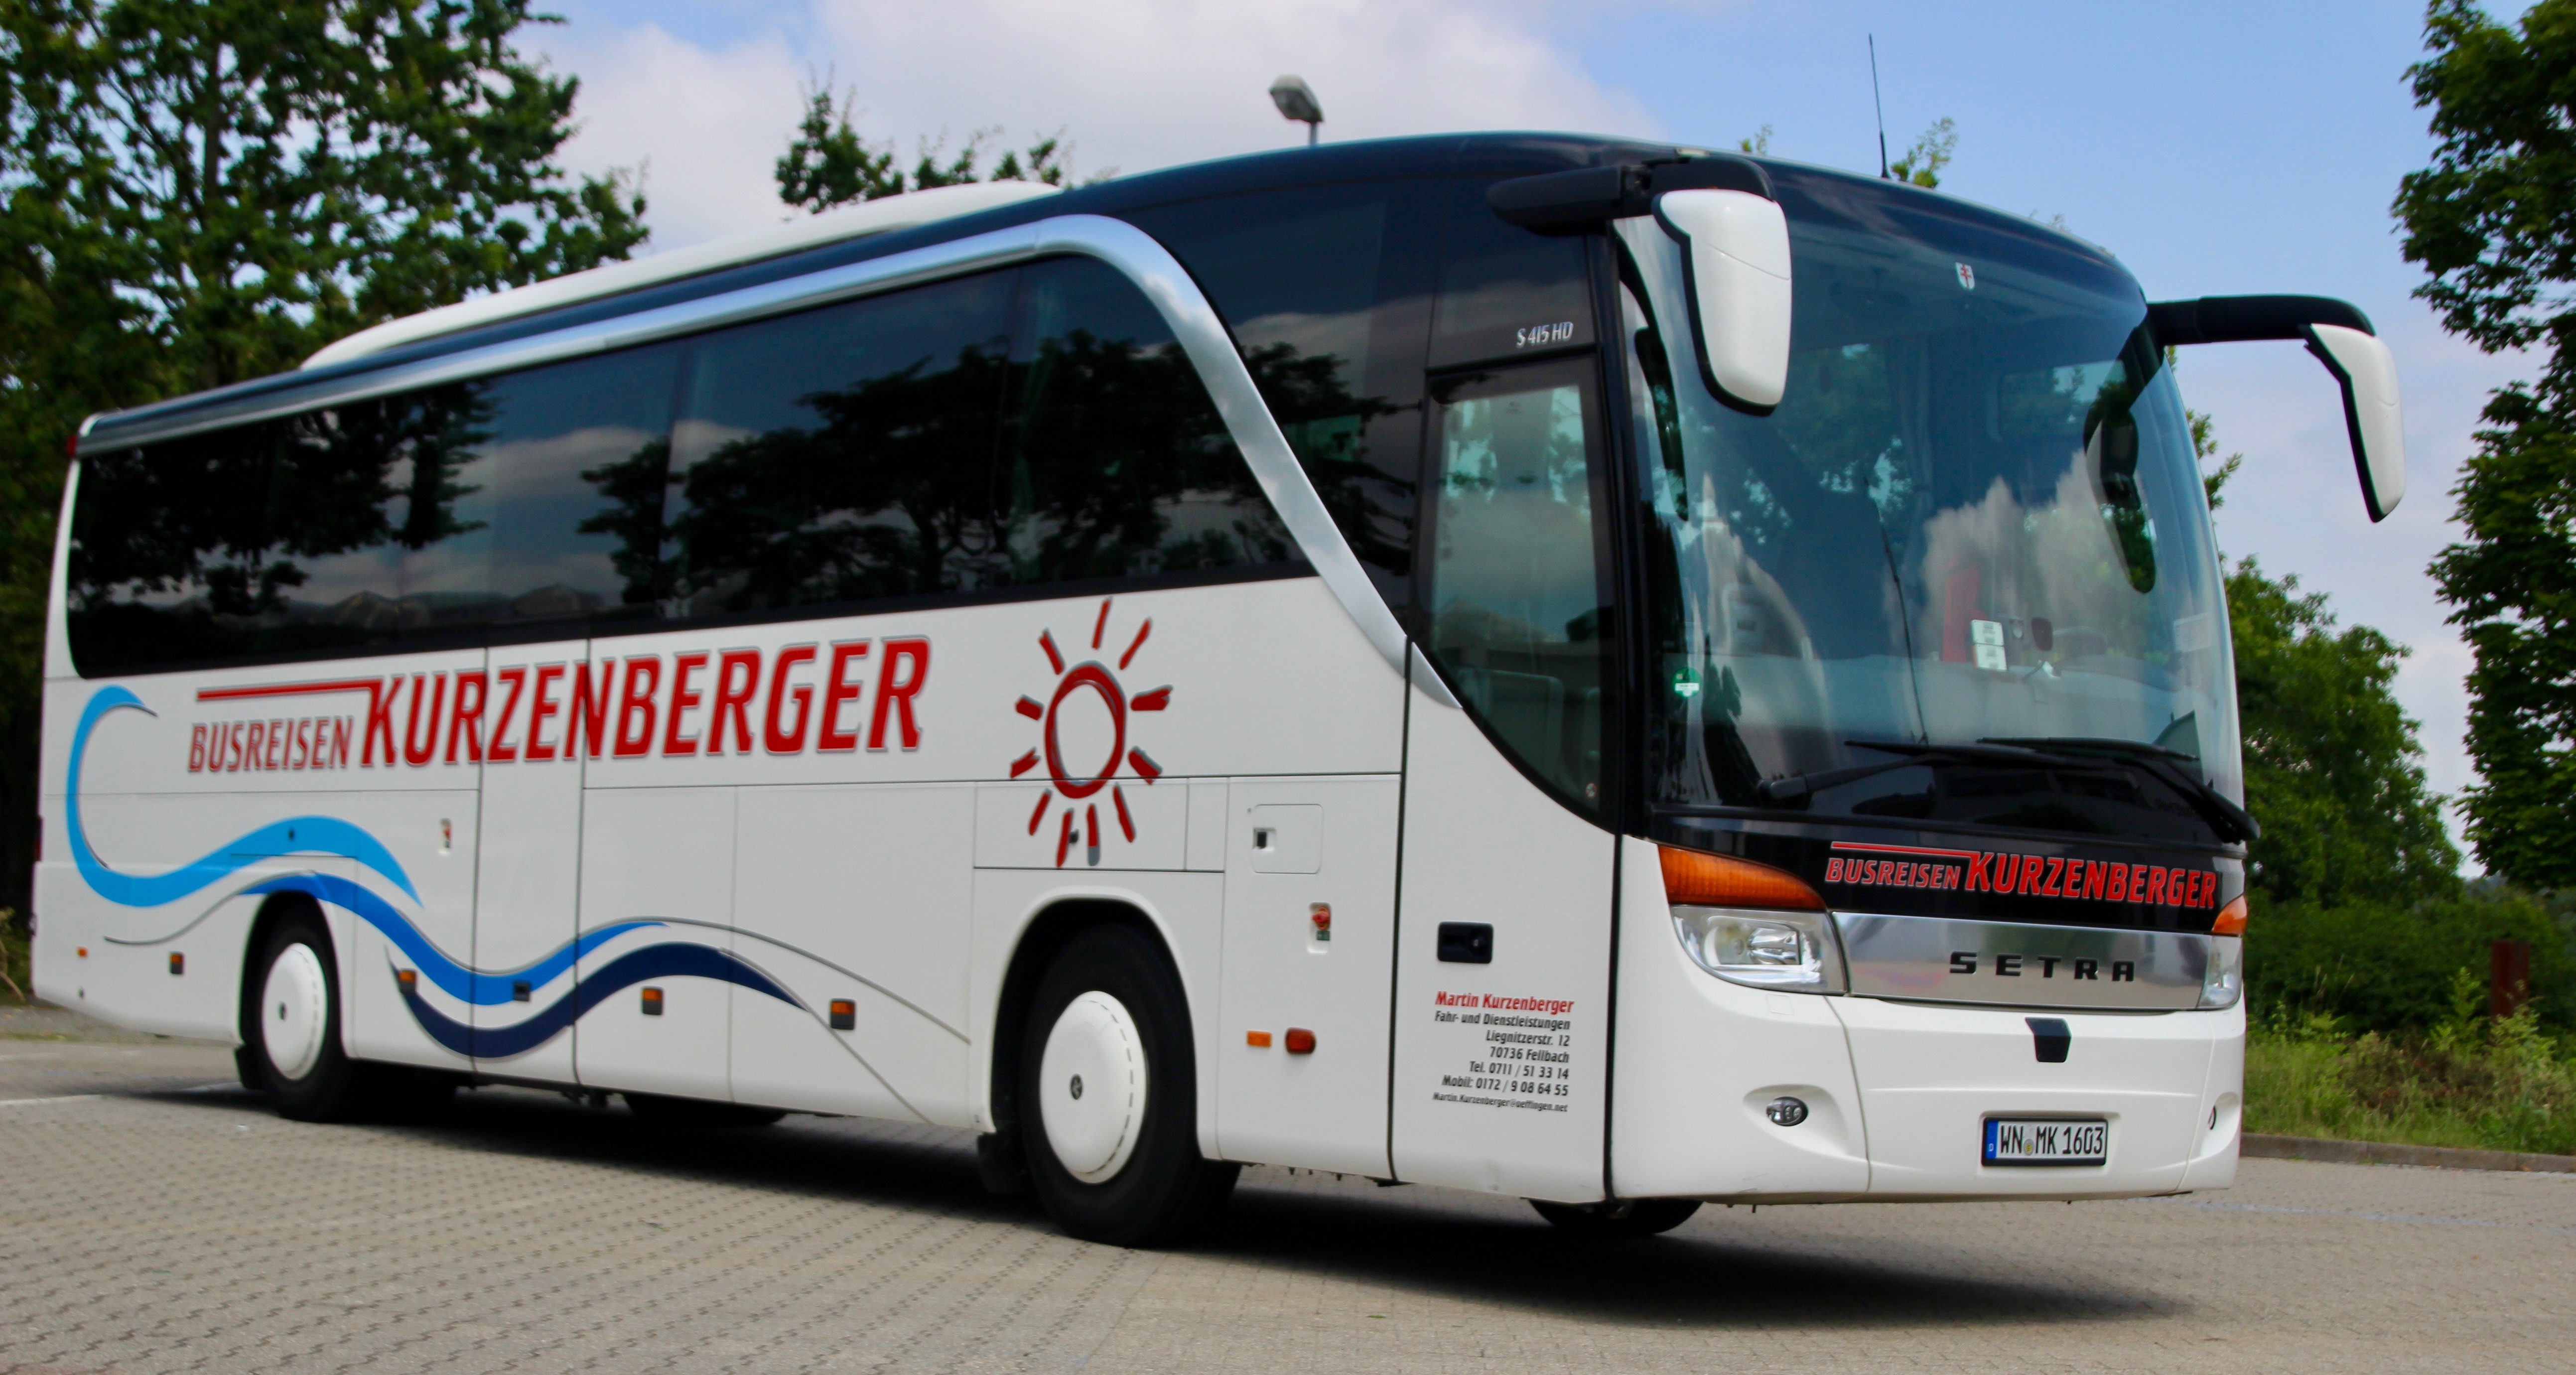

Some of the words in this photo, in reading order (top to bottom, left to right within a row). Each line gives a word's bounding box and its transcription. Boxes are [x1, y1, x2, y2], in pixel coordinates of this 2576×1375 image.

[1516, 328, 1526, 347] S
[1527, 325, 1550, 344] 415
[1552, 321, 1574, 341] HD
[188, 716, 355, 773] BUSREISEN
[361, 635, 931, 767] KURZENBERGER
[1825, 856, 1961, 889] BUSREISEN
[1965, 852, 2218, 908] KURZENBERGER
[1949, 951, 2135, 982] SETRA
[1435, 991, 1479, 1007] Martin
[1482, 993, 1574, 1015] Kurzenberger
[1435, 1010, 1459, 1022] Fahr-
[1461, 1013, 1480, 1024] und
[1483, 1013, 1571, 1031] Dienstleistungen
[1486, 1029, 1553, 1046] Liegnitzerstr.
[1558, 1035, 1570, 1046] 12
[1490, 1046, 1522, 1060] 70736
[1526, 1049, 1569, 1063] Fellbach
[1470, 1061, 1486, 1073] Tel.
[1489, 1063, 1512, 1075] 0711
[1515, 1065, 1521, 1077] /
[1523, 1065, 1534, 1077] 51
[1539, 1067, 1552, 1078] 33
[1557, 1068, 1569, 1080] 14
[1442, 1075, 1473, 1088] Mobil:
[1476, 1078, 1500, 1090] 0172
[1502, 1080, 1508, 1093] /
[1511, 1081, 1517, 1093] 9
[1520, 1082, 1534, 1093] 08
[1537, 1083, 1551, 1095] 64
[1554, 1084, 1568, 1096] 55
[2000, 1125, 2024, 1154] WN
[2035, 1126, 2058, 1154] MK
[2062, 1126, 2104, 1155] 1603
